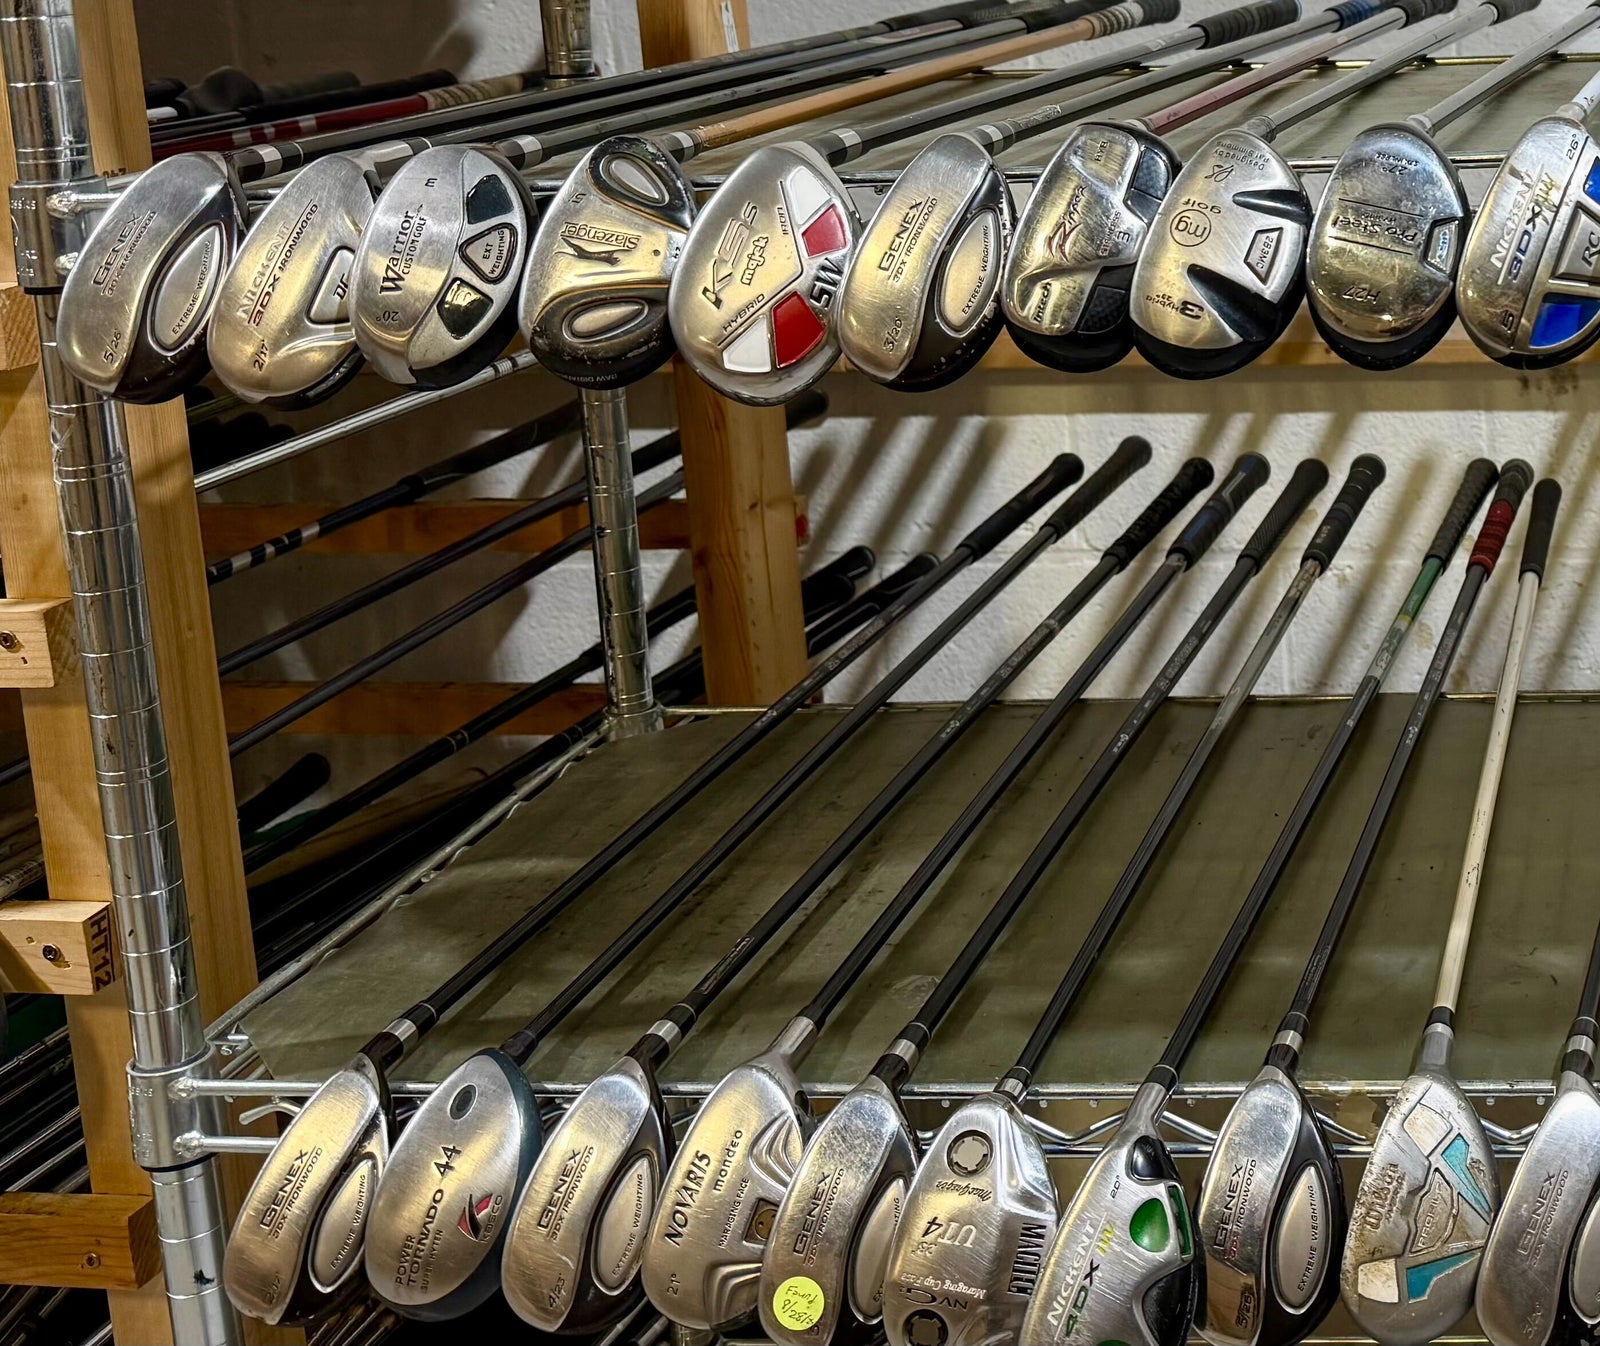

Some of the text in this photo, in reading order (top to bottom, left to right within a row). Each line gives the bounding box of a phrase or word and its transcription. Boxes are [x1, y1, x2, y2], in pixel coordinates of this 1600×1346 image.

[561, 222, 642, 250] Slazenger
[777, 206, 790, 236] IRON
[878, 199, 924, 273] GENEX
[892, 197, 938, 284] 3DX IRONWOOD
[1174, 215, 1208, 239] mg
[1181, 197, 1222, 215] golf
[1332, 215, 1382, 235] Steel
[92, 214, 142, 285] GENEX
[253, 203, 319, 327] 3DX IRONWOOD
[379, 211, 416, 296] Warrior
[401, 216, 428, 276] CUSTOM GOLF
[482, 242, 495, 260] EXT
[488, 230, 505, 276] WEIGHTING
[740, 236, 770, 286] majek
[961, 225, 989, 316] EXTREME WEIGHTING
[1507, 204, 1544, 283] 3DX
[172, 241, 211, 335] EXTREME WEIGHTING
[722, 293, 766, 334] HYBRID
[1034, 282, 1053, 324] Intech
[1146, 294, 1205, 321] 3 Hybrid
[1501, 311, 1515, 334] 5
[88, 912, 116, 992] HT12
[260, 1149, 309, 1229] GENEX
[272, 1146, 324, 1241] 3DX IRONWOOD
[432, 1143, 462, 1178] 44
[537, 1149, 582, 1231] GENEX
[551, 1145, 595, 1242] 3DX IRONWOOD
[1236, 1159, 1257, 1231] IRONWOOD
[352, 1174, 367, 1227] WEIGHTING
[611, 1173, 644, 1277] EXTREME WEIGHTING
[664, 1149, 712, 1248] NOVARIS
[719, 1177, 750, 1249] MARAGING FACE
[792, 1171, 833, 1256] GENEX
[815, 1167, 845, 1240] IRONWOOD
[1213, 1163, 1243, 1250] GENEX
[1517, 1170, 1557, 1256] GENEX
[1542, 1168, 1570, 1240] IRONWOOD
[394, 1234, 416, 1287] POWER
[406, 1187, 445, 1288] TORNADO
[1047, 1219, 1097, 1327] NICKENT
[1297, 1184, 1321, 1293] EXTREME WEIGHTING
[667, 1272, 680, 1297] 21°
[785, 1284, 818, 1306] Found
[900, 1271, 988, 1301] Maraging Cup Face
[1065, 1258, 1101, 1339] 4DX
